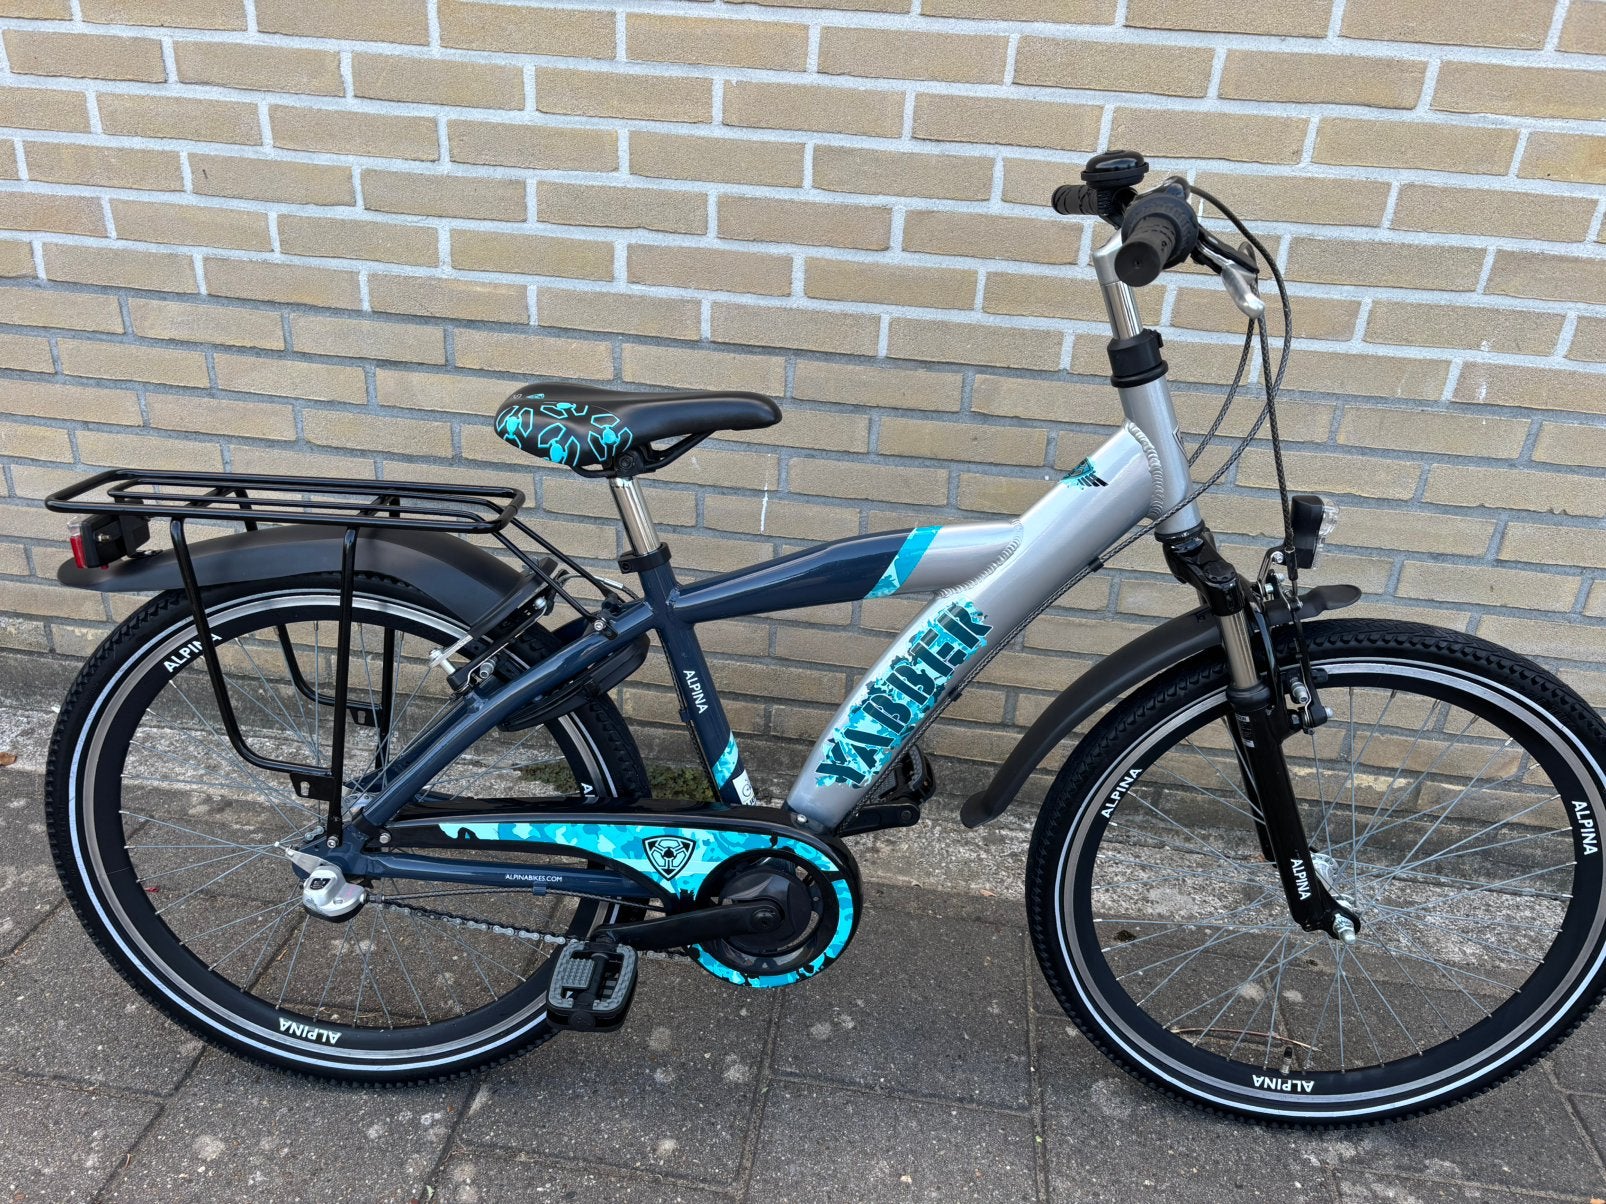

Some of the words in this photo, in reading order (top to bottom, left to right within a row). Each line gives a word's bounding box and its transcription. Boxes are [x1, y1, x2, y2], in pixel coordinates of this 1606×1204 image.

[682, 670, 709, 714] ALPINA
[815, 605, 994, 786] YABBER
[1101, 769, 1143, 819] ALPINA
[1571, 800, 1599, 856] ALPINA
[504, 873, 563, 882] ALPINABIKES.COM
[1290, 858, 1312, 900] ALPINA
[278, 1016, 343, 1045] ALPINA
[1252, 1074, 1315, 1093] ALPINA
